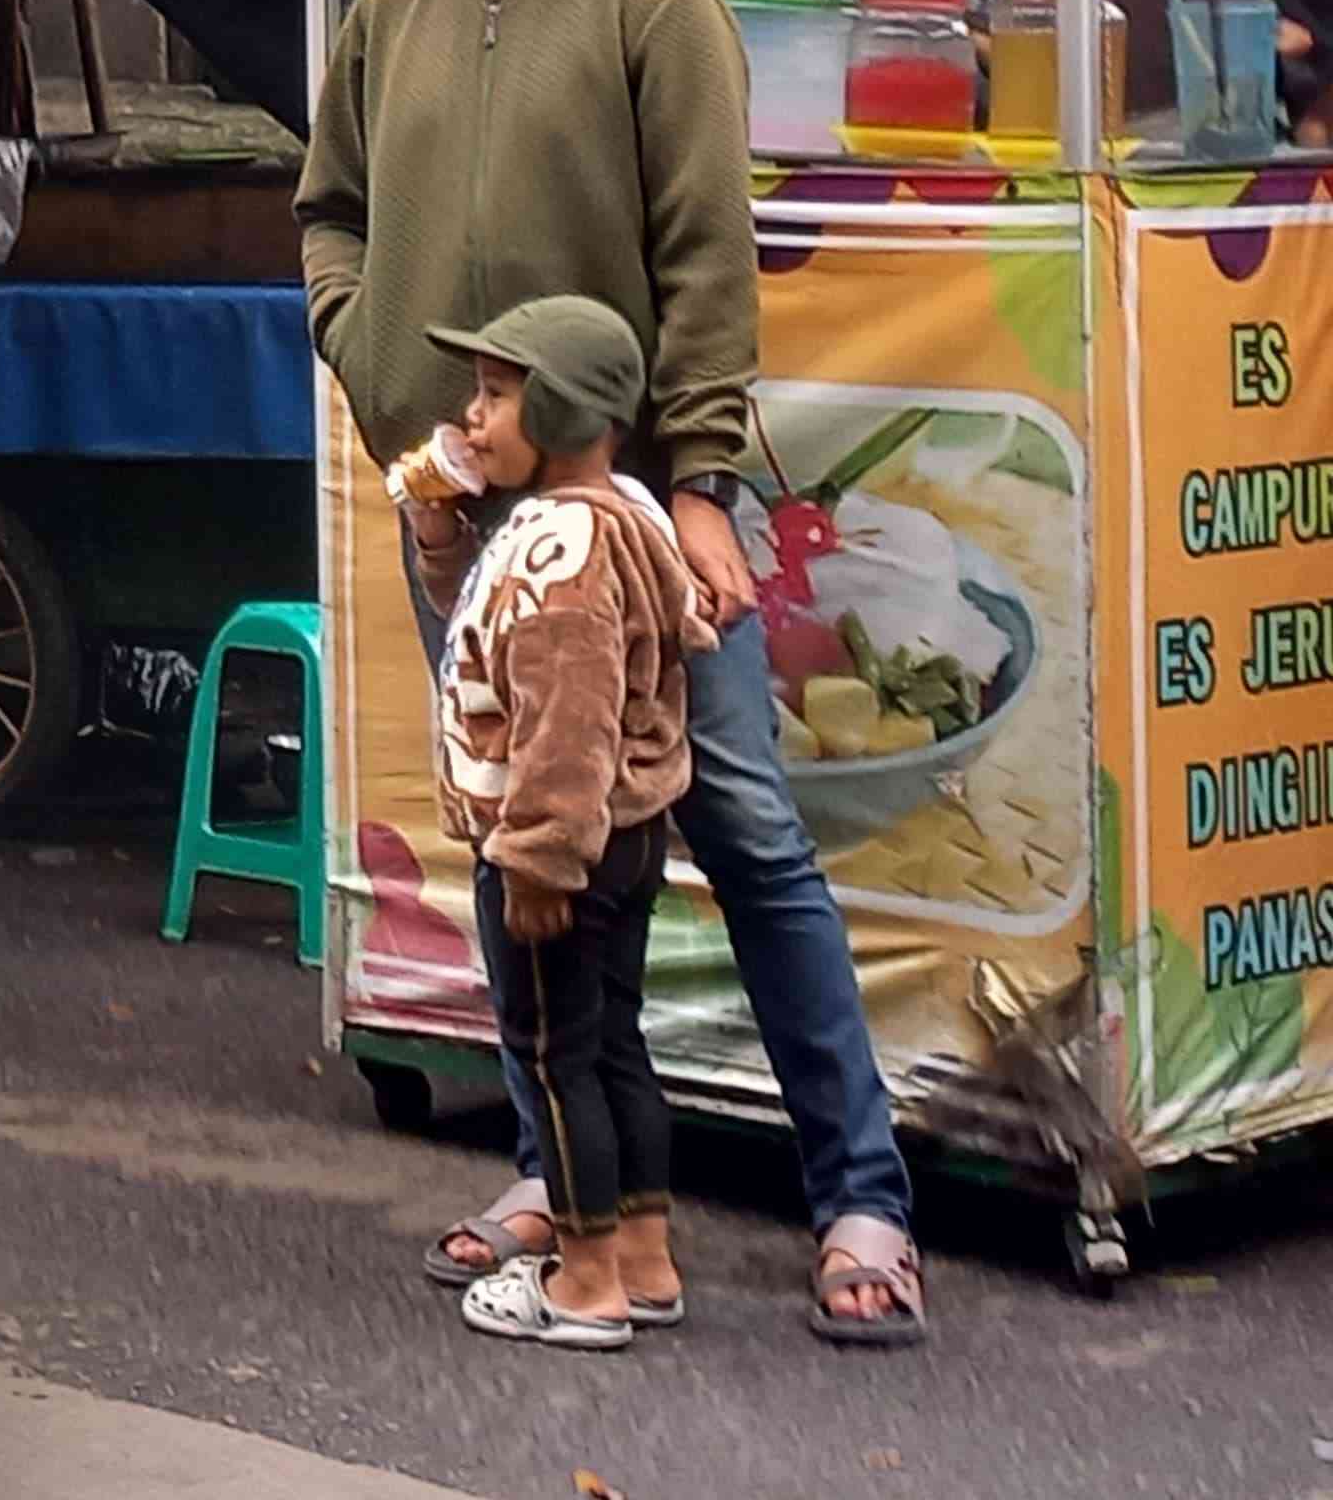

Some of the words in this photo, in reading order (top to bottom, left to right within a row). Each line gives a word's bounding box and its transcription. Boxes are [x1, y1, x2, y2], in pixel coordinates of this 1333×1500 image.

[1231, 322, 1292, 407] ES
[1156, 616, 1216, 707] ES
[1204, 881, 1333, 991] PANAS
